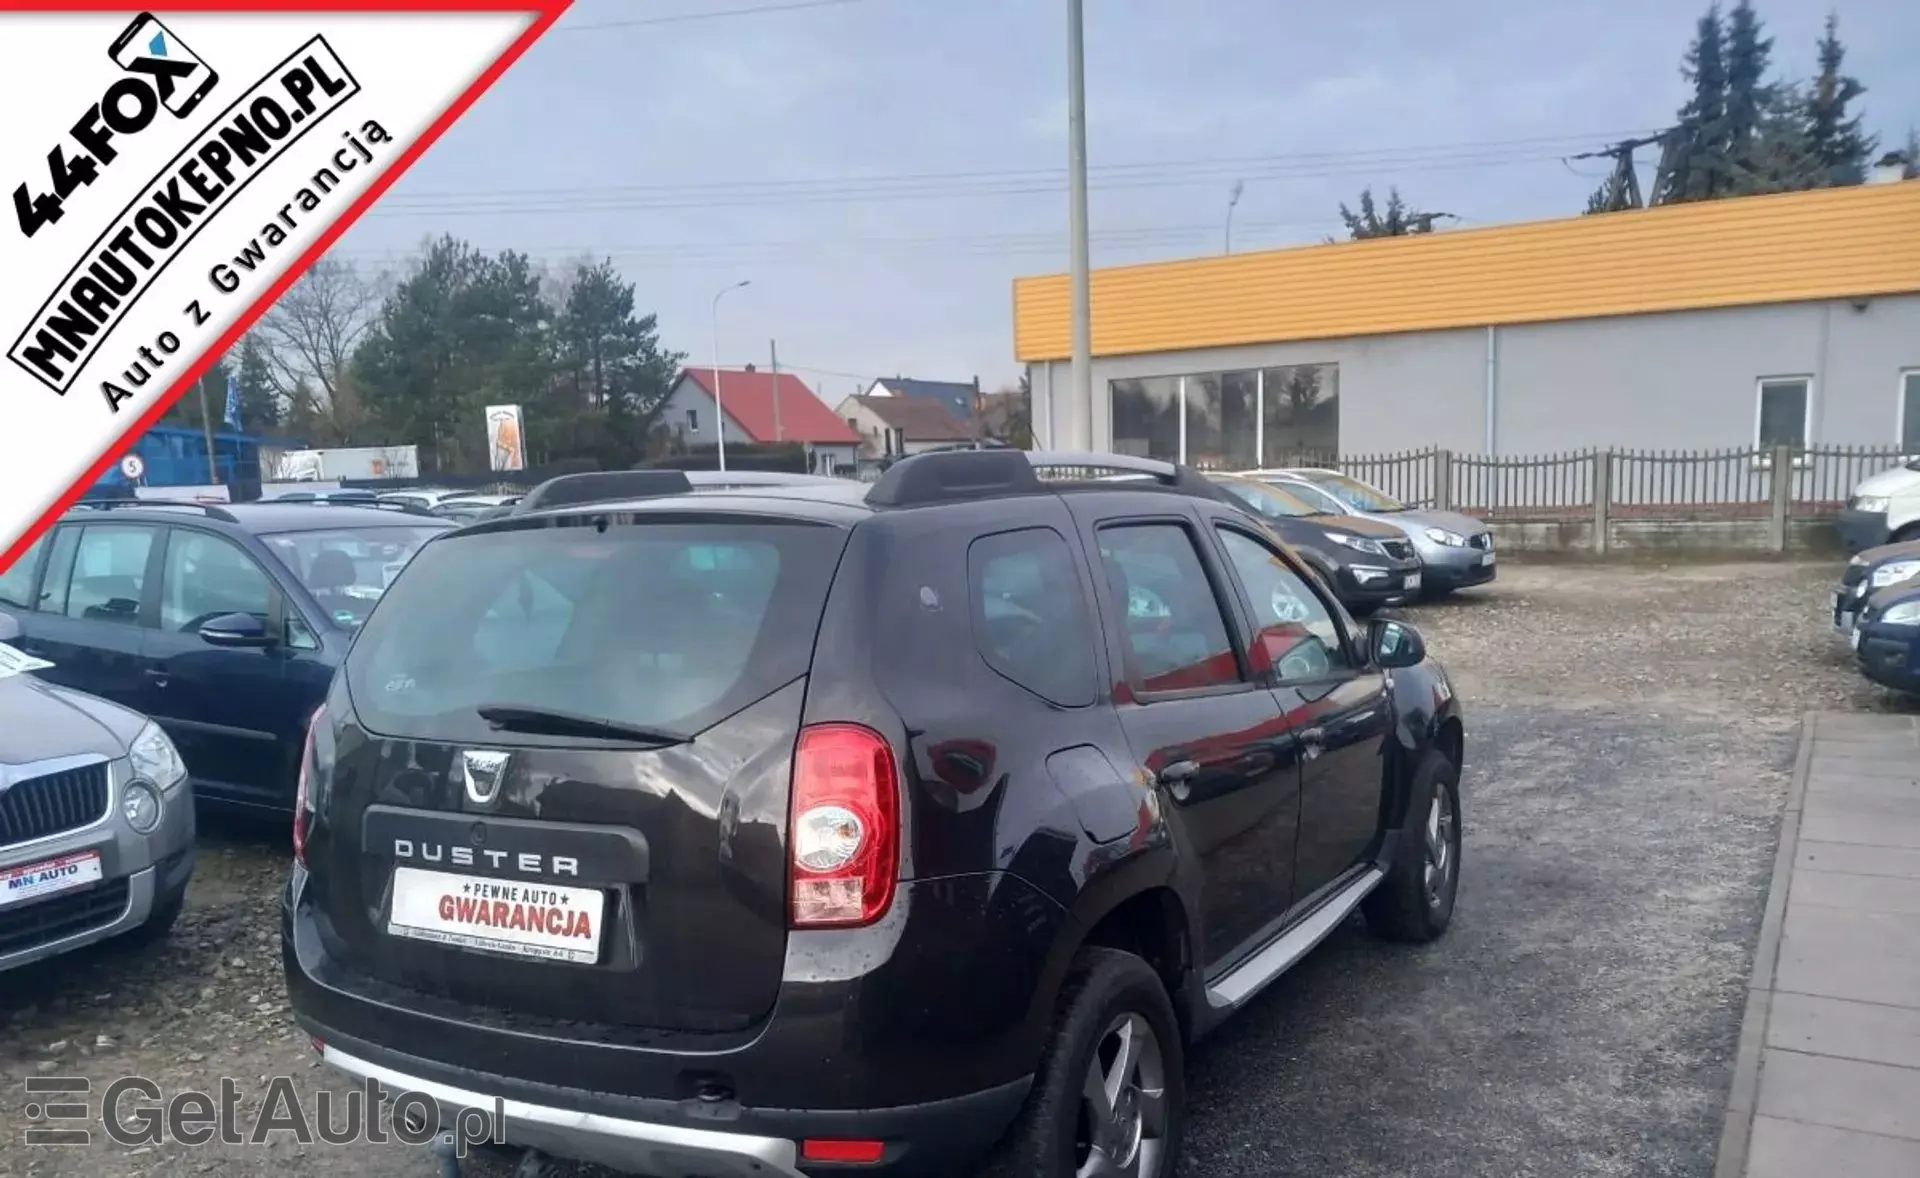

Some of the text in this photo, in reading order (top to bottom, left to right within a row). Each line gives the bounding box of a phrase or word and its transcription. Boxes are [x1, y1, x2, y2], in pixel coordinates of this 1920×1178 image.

[395, 839, 579, 876] DUSTER
[8, 875, 34, 889] MN
[39, 864, 79, 882] AUTO
[474, 883, 557, 905] PEWNE AUTO
[438, 894, 591, 939] GWARANCJA
